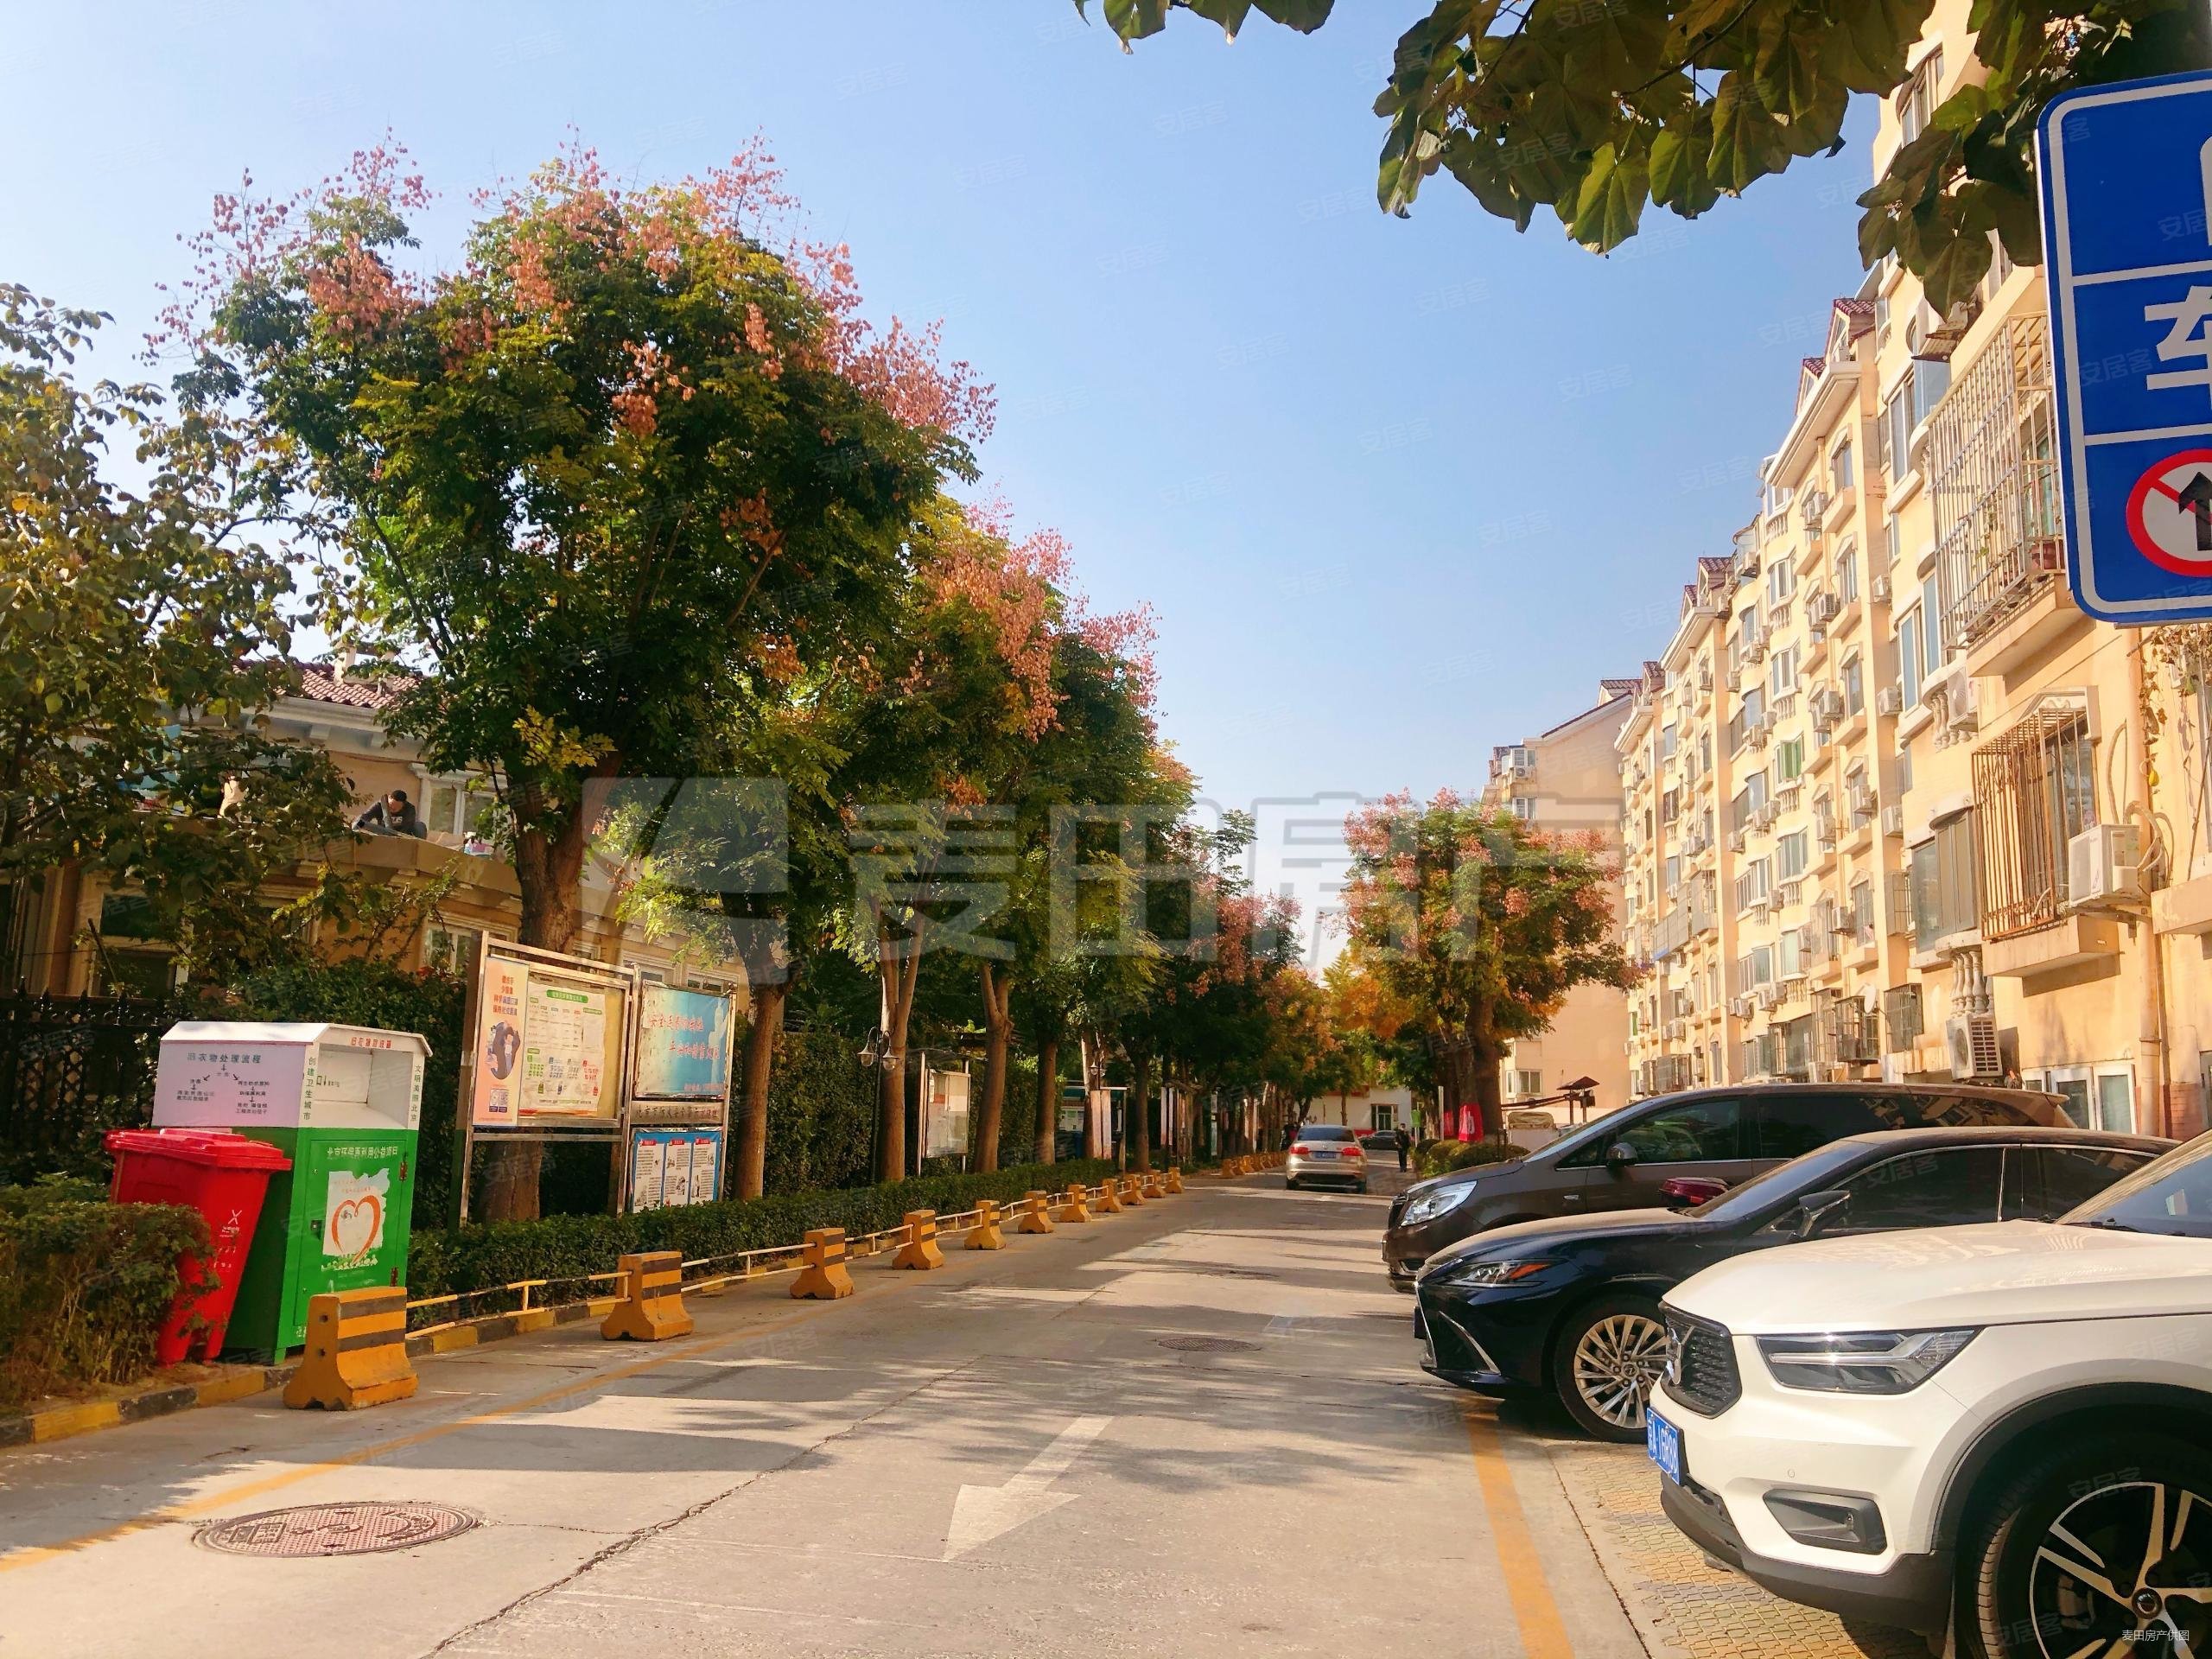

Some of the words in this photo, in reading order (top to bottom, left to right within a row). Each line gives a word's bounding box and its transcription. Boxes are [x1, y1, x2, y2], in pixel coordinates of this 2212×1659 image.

[303, 1057, 316, 1121] 创建卫生城市
